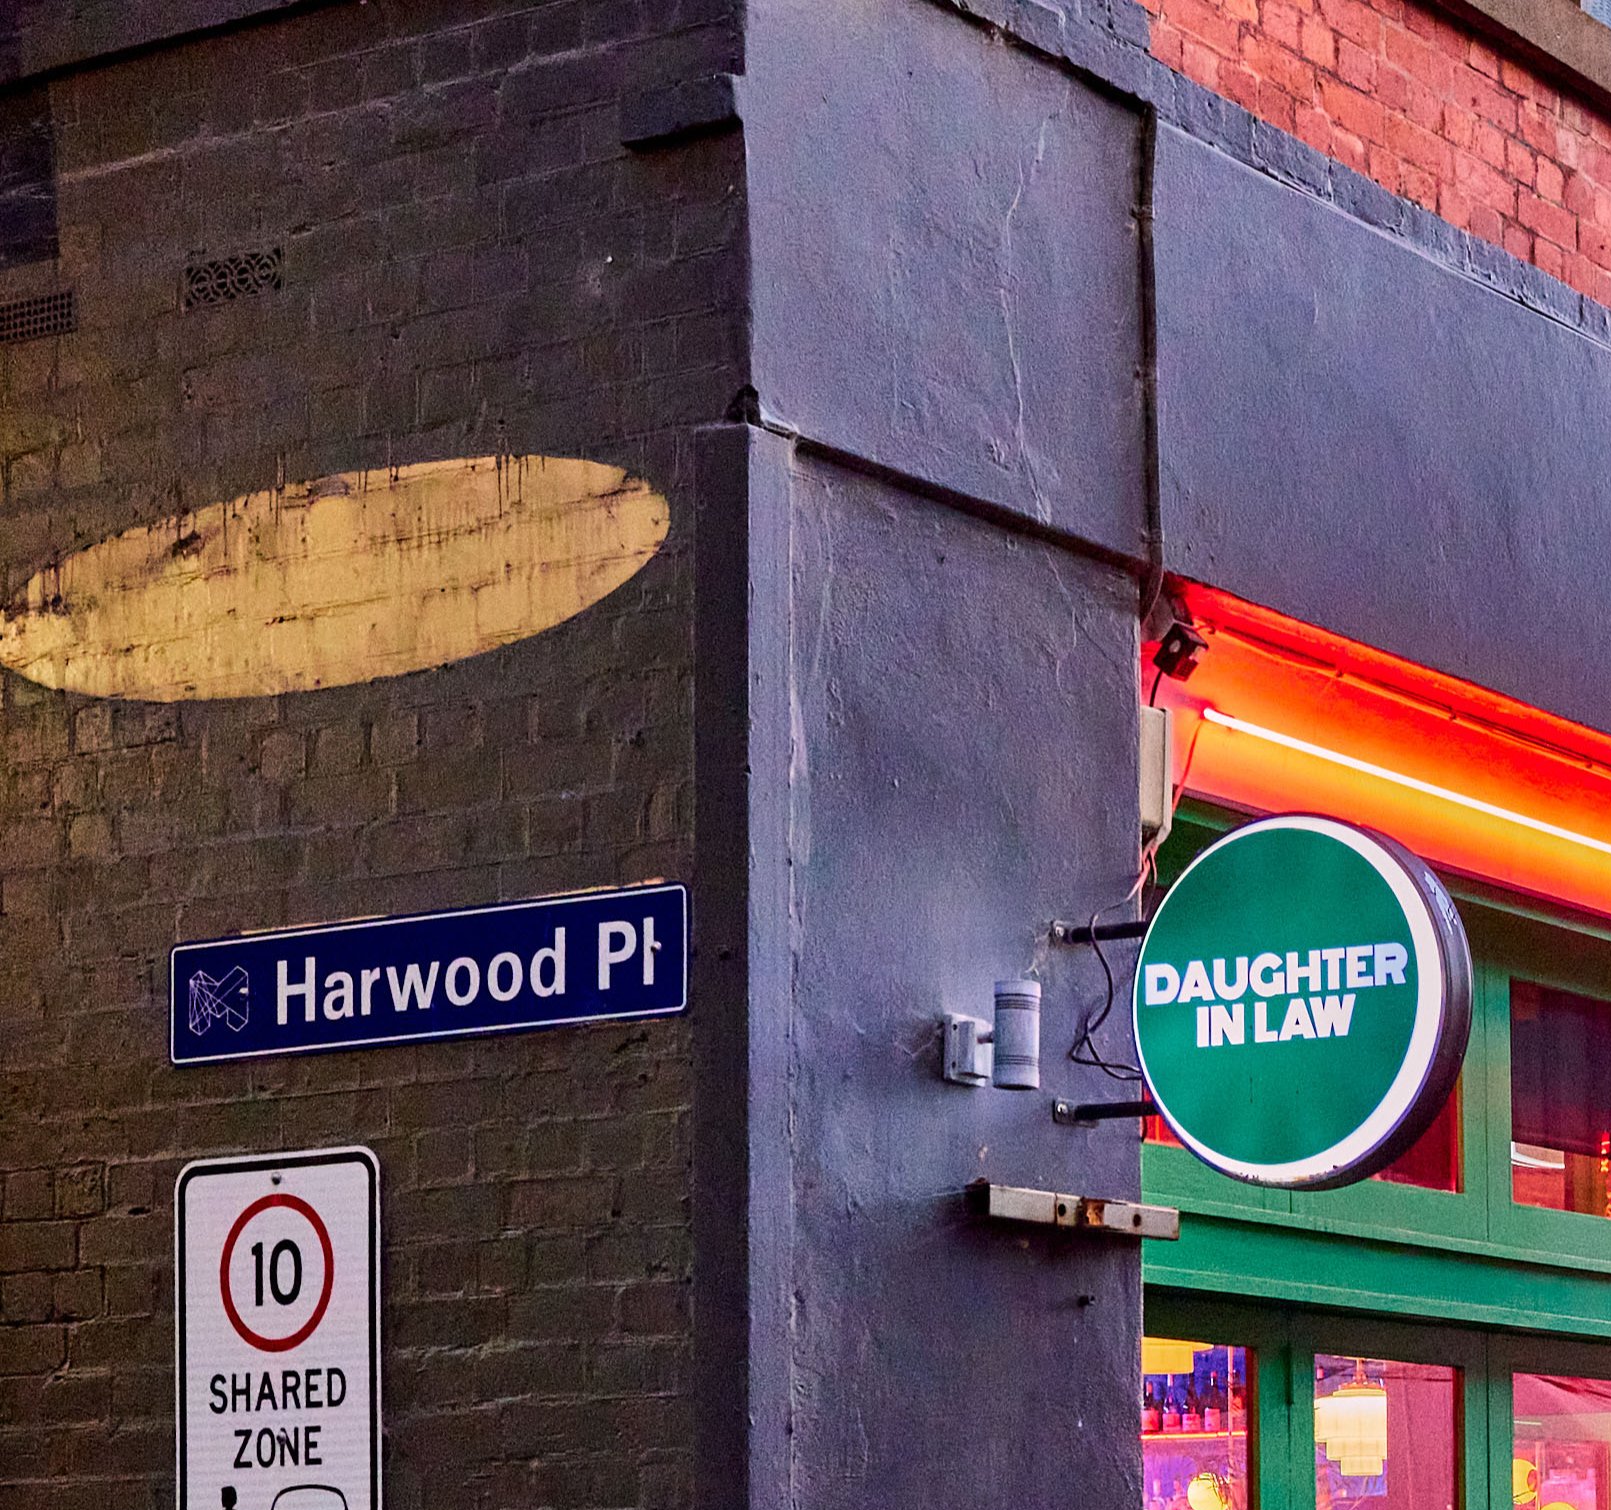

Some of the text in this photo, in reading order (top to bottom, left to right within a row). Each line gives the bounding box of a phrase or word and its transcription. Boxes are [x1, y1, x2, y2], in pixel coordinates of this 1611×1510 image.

[276, 916, 656, 1026] Harwood Pl
[1144, 942, 1409, 1006] DAUGHTER
[1196, 994, 1356, 1048] IN LAW
[251, 1239, 303, 1307] 10
[209, 1368, 347, 1415] SHARED
[234, 1425, 323, 1469] ZONE
